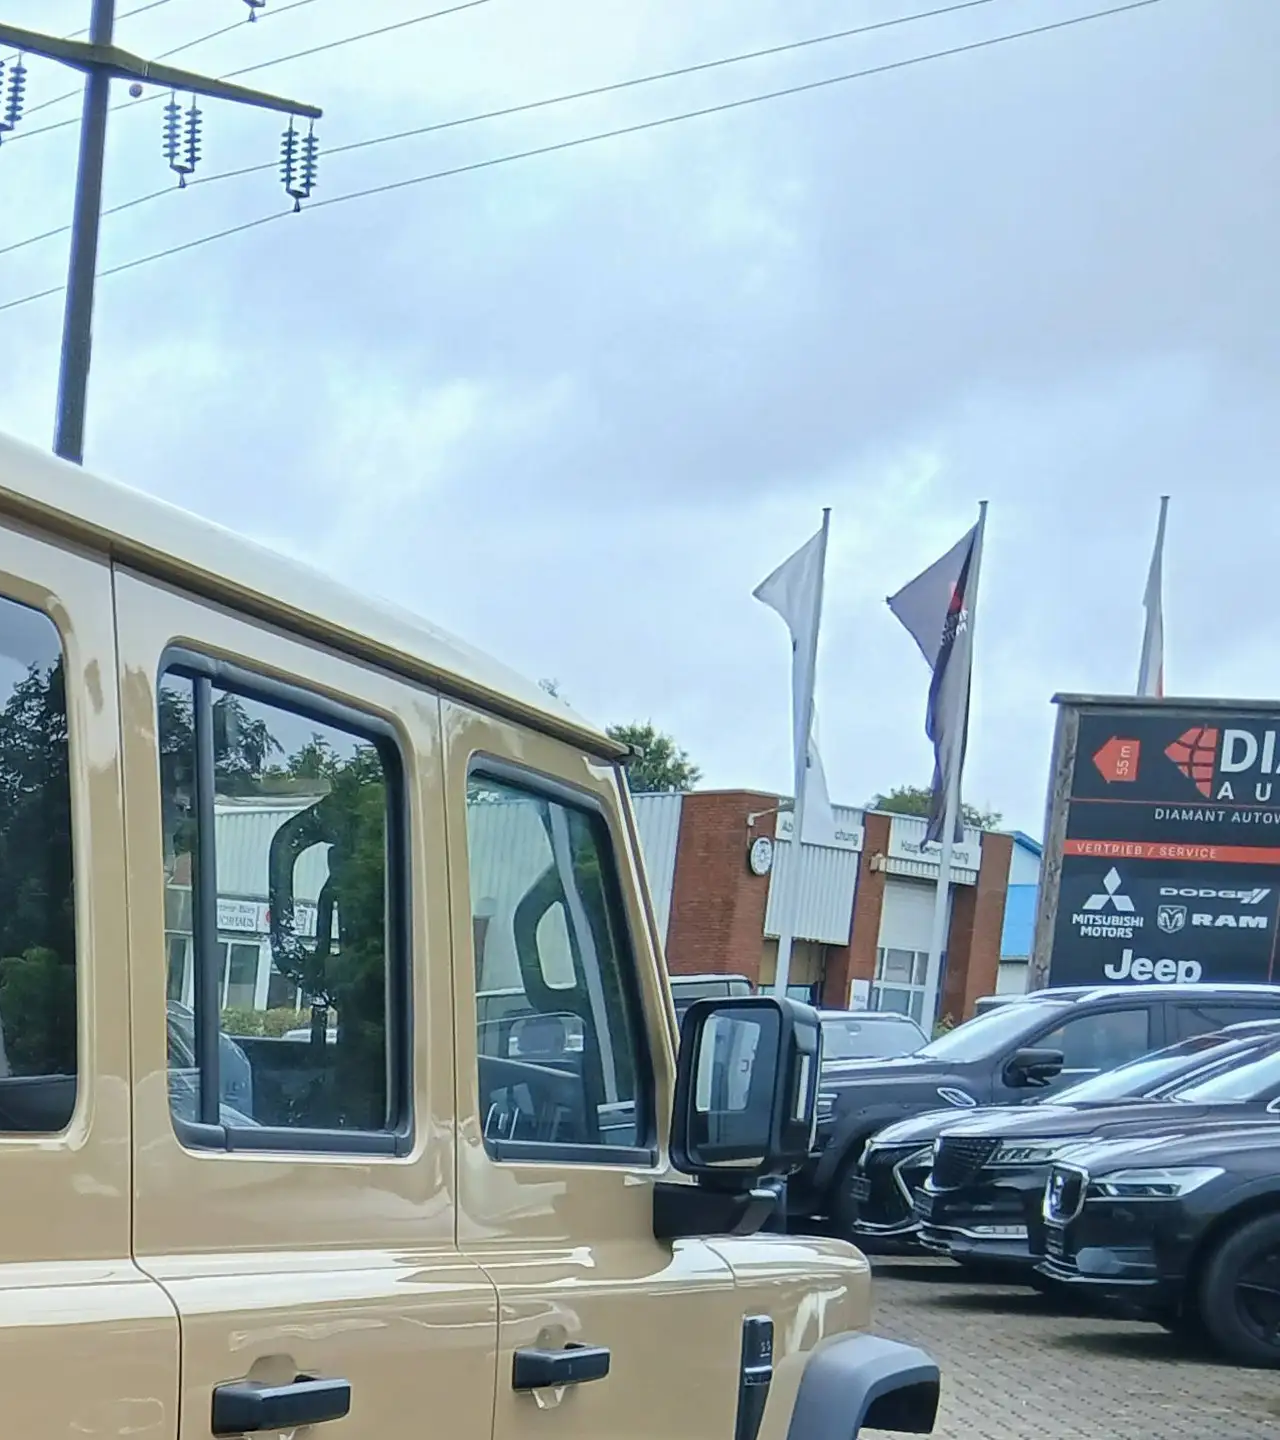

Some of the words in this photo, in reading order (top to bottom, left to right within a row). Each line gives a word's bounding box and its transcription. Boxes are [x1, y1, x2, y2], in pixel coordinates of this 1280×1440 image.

[1219, 729, 1280, 774] DI
[1154, 808, 1225, 822] DIAMANT
[1076, 843, 1143, 856] VERTRIEB
[1159, 846, 1218, 859] SERVICE
[1159, 887, 1250, 899] DODGE
[1072, 913, 1144, 928] MITSUBISHI
[1191, 913, 1268, 928] RAM
[1080, 926, 1133, 938] MOTORS
[1104, 949, 1202, 983] Jeep
